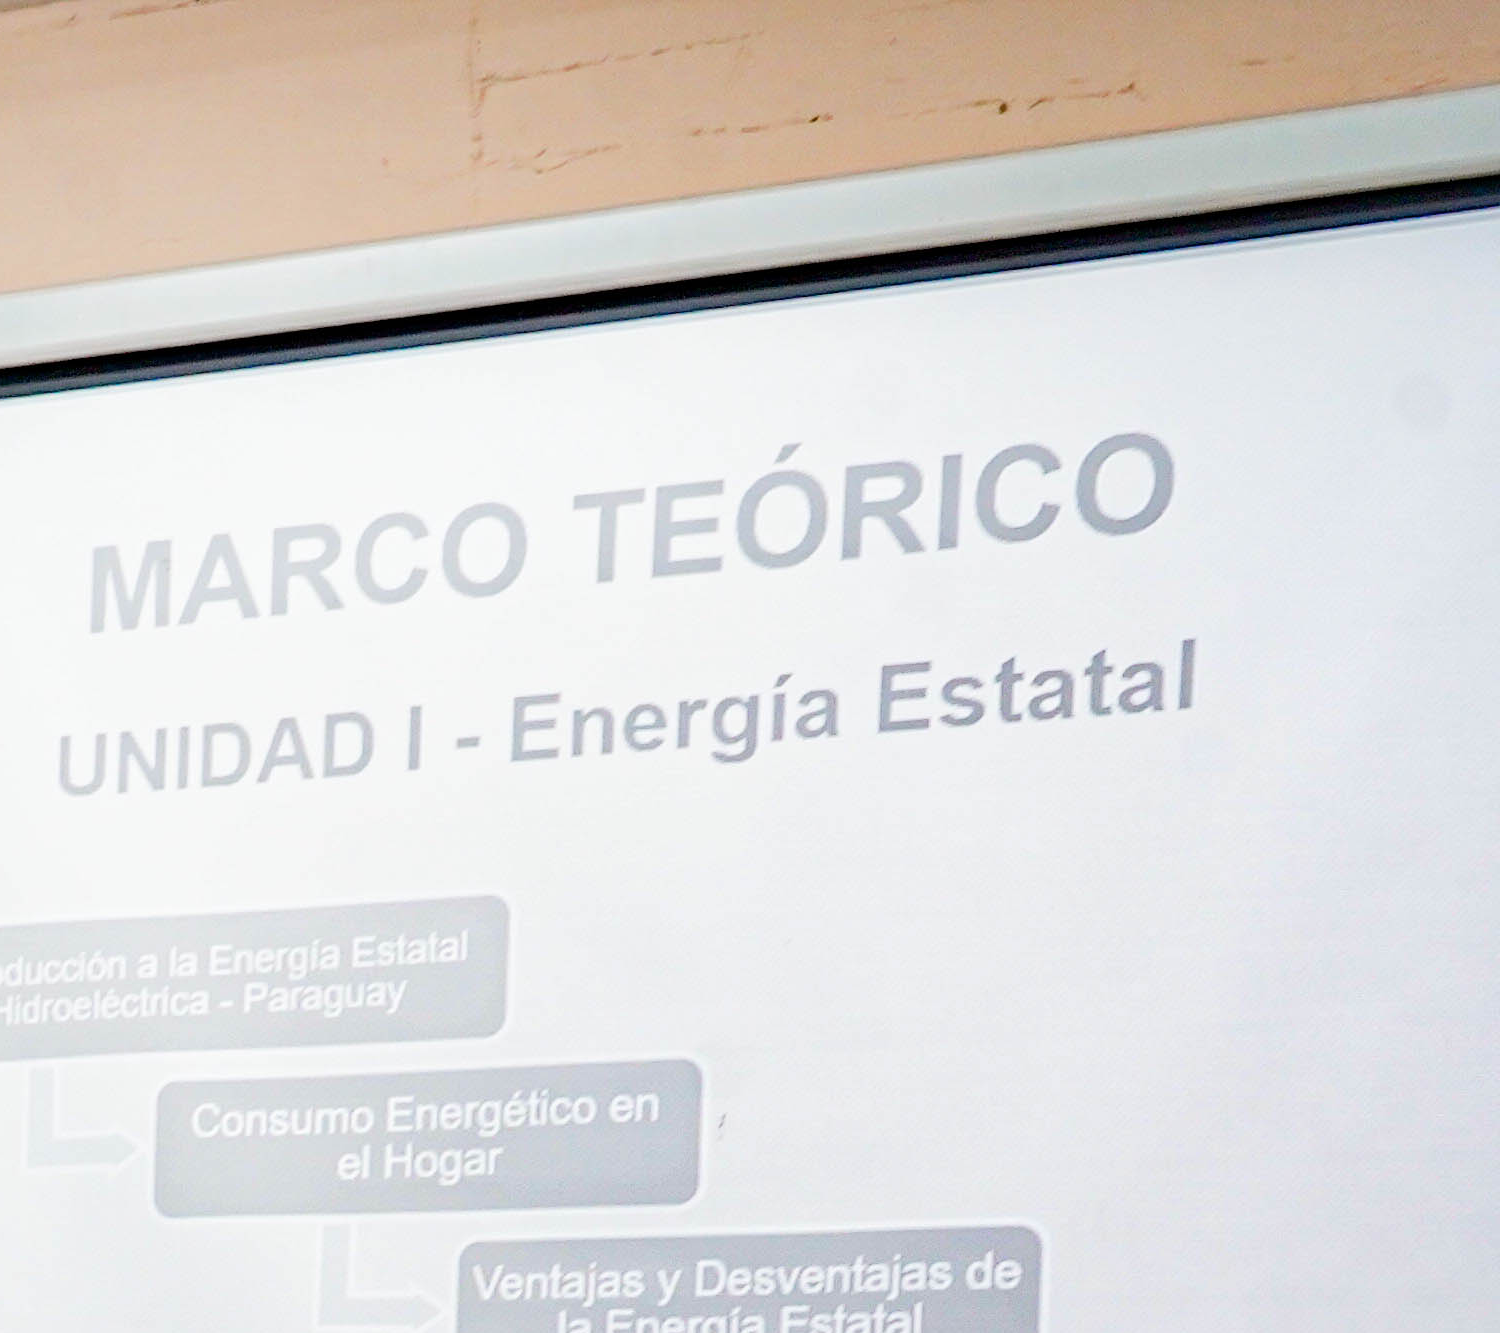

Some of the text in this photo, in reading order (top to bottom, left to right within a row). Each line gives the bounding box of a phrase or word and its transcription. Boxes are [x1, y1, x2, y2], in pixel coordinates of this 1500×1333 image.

[90, 431, 1174, 633] MARCO TEÓRICO
[59, 711, 373, 795] UNIDAD
[408, 705, 421, 770] I
[877, 638, 1196, 733] Estatal
[136, 953, 157, 978] a
[169, 945, 198, 977] la
[351, 927, 468, 968] Estatal
[243, 979, 408, 1018] Paraguay
[191, 1088, 659, 1137] Consumo Energético en
[337, 1141, 504, 1186] el Hogar
[472, 1249, 1023, 1307] Ventajas y Desventajas de
